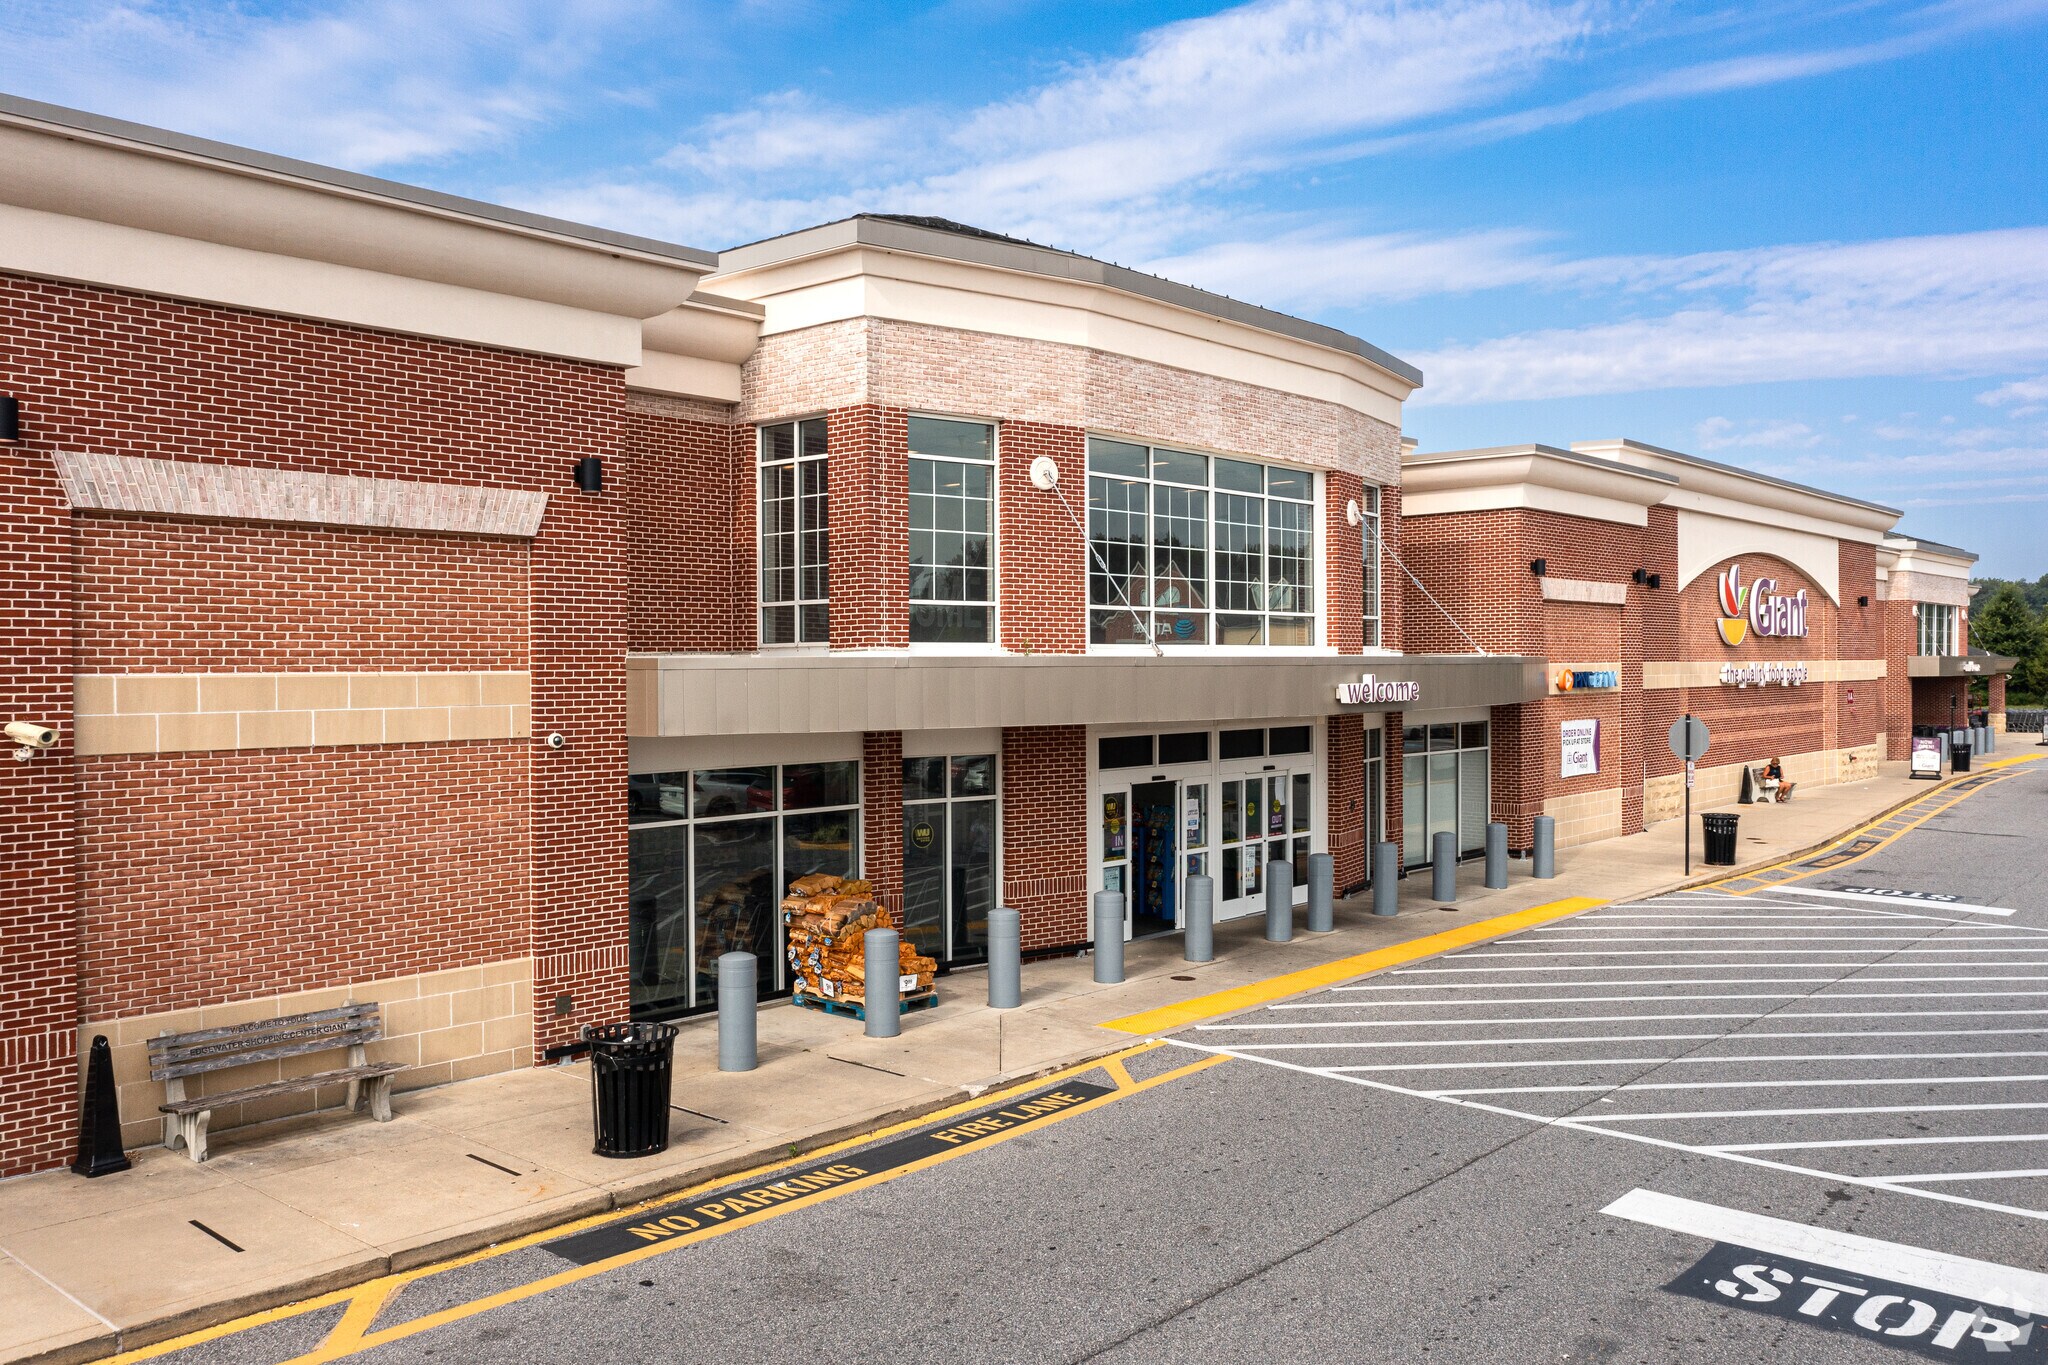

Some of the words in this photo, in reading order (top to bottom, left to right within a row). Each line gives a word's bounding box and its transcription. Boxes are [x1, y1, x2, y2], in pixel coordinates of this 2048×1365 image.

[1750, 577, 1808, 637] Giant
[1724, 662, 1740, 682] the
[1741, 662, 1766, 687] quality
[1767, 662, 1784, 682] food
[1785, 662, 1808, 686] people
[1344, 674, 1419, 703] welcome
[1562, 729, 1577, 738] ORDER
[1577, 728, 1592, 736] ONLINE
[1573, 751, 1588, 763] Giant
[1271, 814, 1282, 824] OUT
[1114, 835, 1124, 847] IN
[1845, 887, 1956, 901] STOP
[230, 1020, 271, 1034] WELCOME
[273, 1019, 284, 1027] TO
[286, 1014, 308, 1025] YOUR
[190, 1040, 244, 1056] EDGEWATER
[245, 1033, 288, 1047] SHOPPING
[290, 1027, 322, 1039] CENTER
[323, 1022, 348, 1033] GIANT
[626, 1215, 700, 1241] NO
[694, 1164, 868, 1220] PARKING
[930, 1116, 1014, 1144] FIRE
[998, 1091, 1085, 1120] LANE
[1714, 1264, 2021, 1349] STOP
